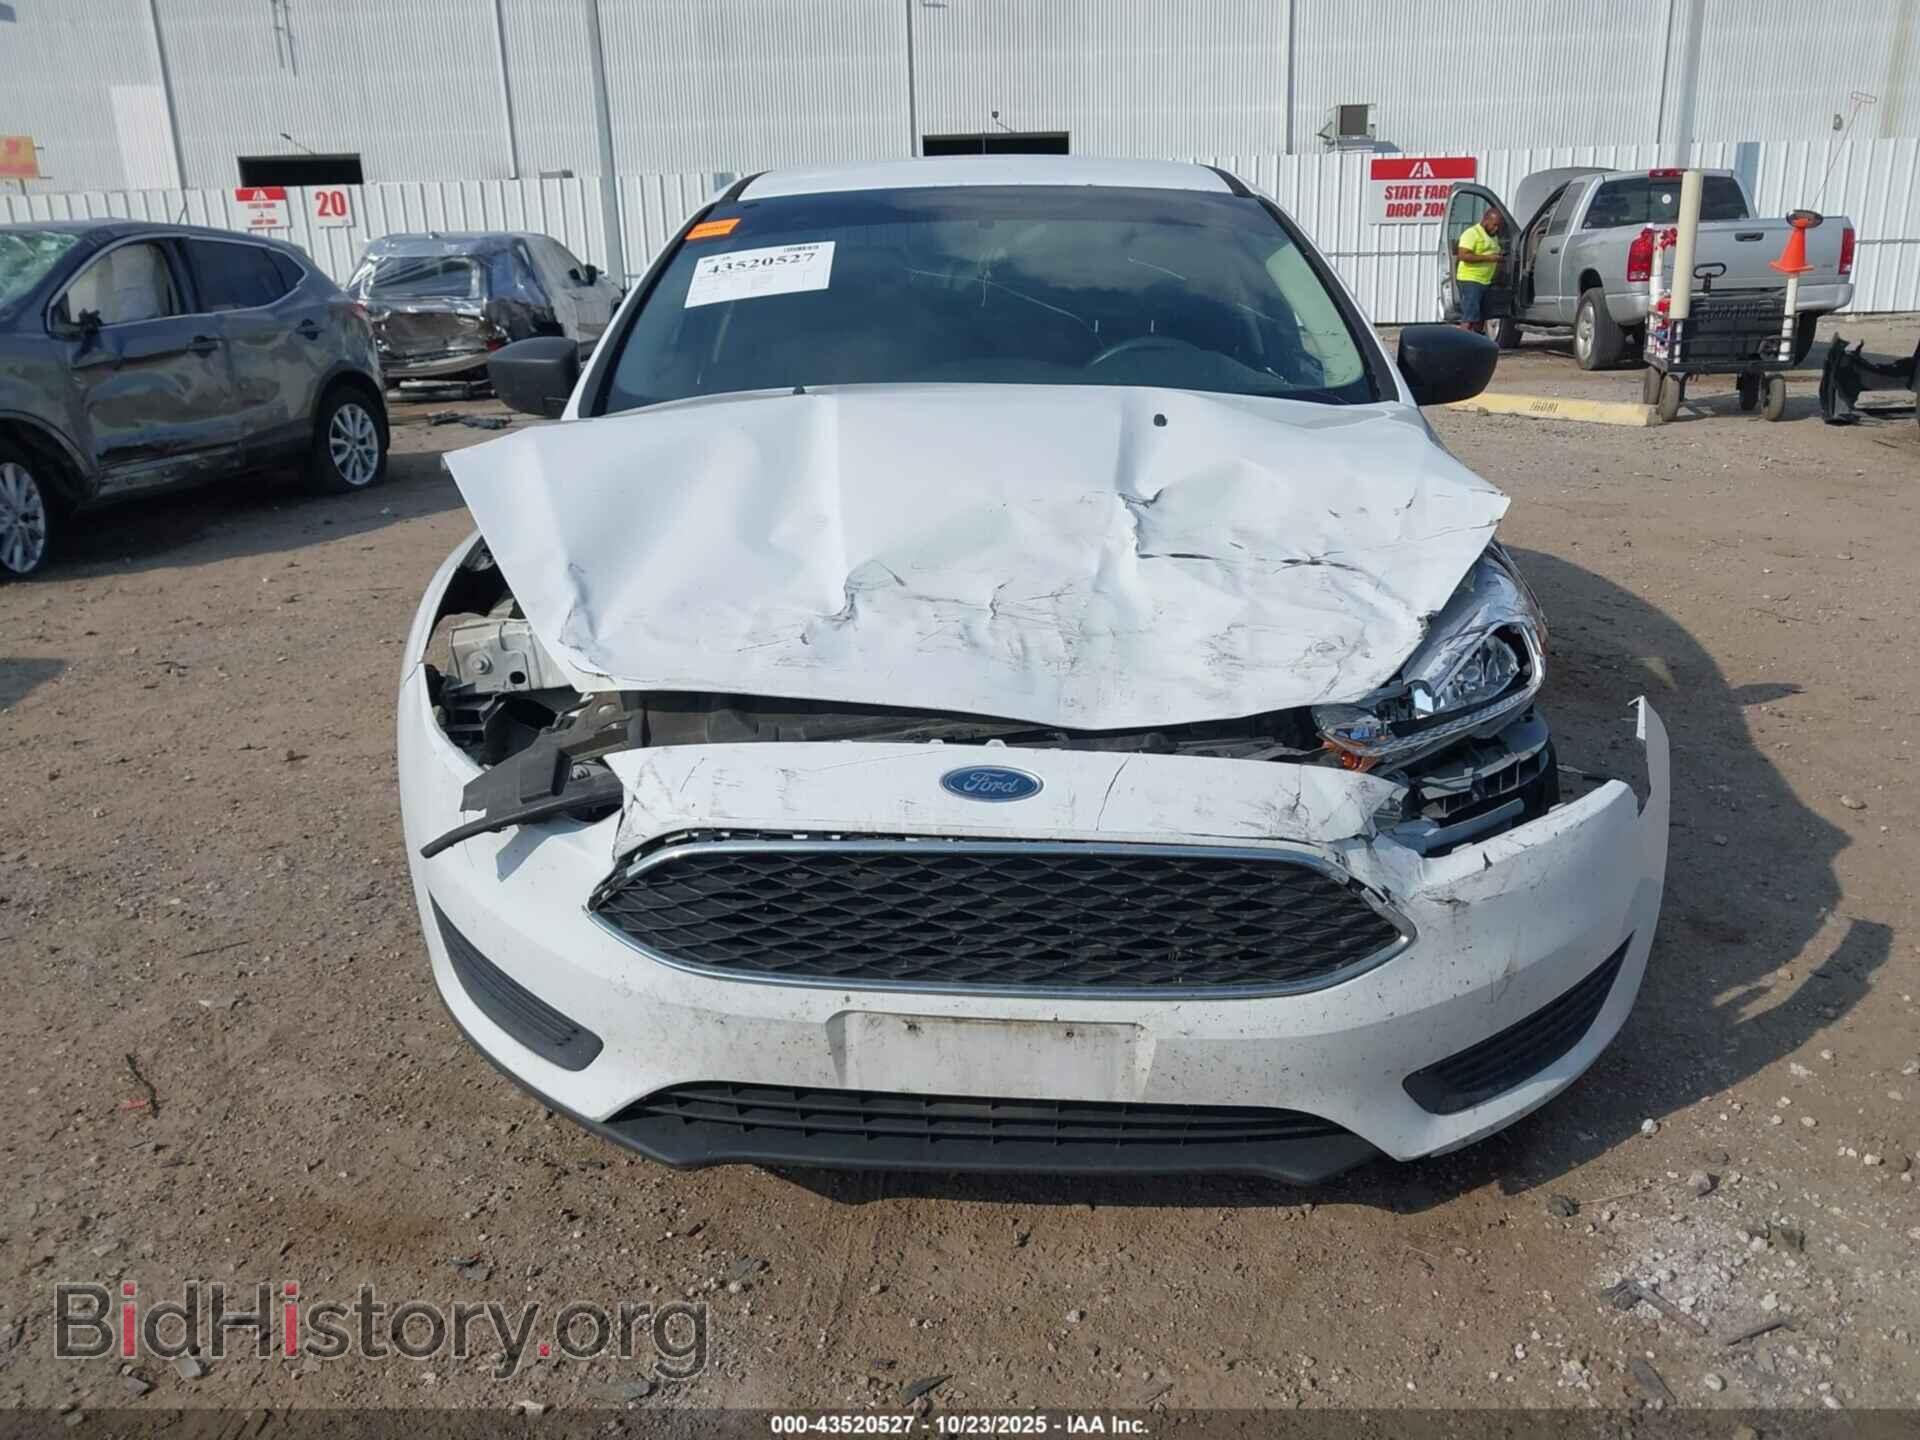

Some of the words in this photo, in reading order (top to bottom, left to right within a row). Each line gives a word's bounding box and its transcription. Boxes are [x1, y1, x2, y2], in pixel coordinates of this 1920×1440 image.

[316, 190, 347, 217] 20
[1385, 185, 1422, 200] STATE
[1385, 203, 1422, 217] DROP
[1423, 202, 1447, 217] ZON
[707, 252, 816, 274] 43520527
[963, 771, 1018, 793] Ford
